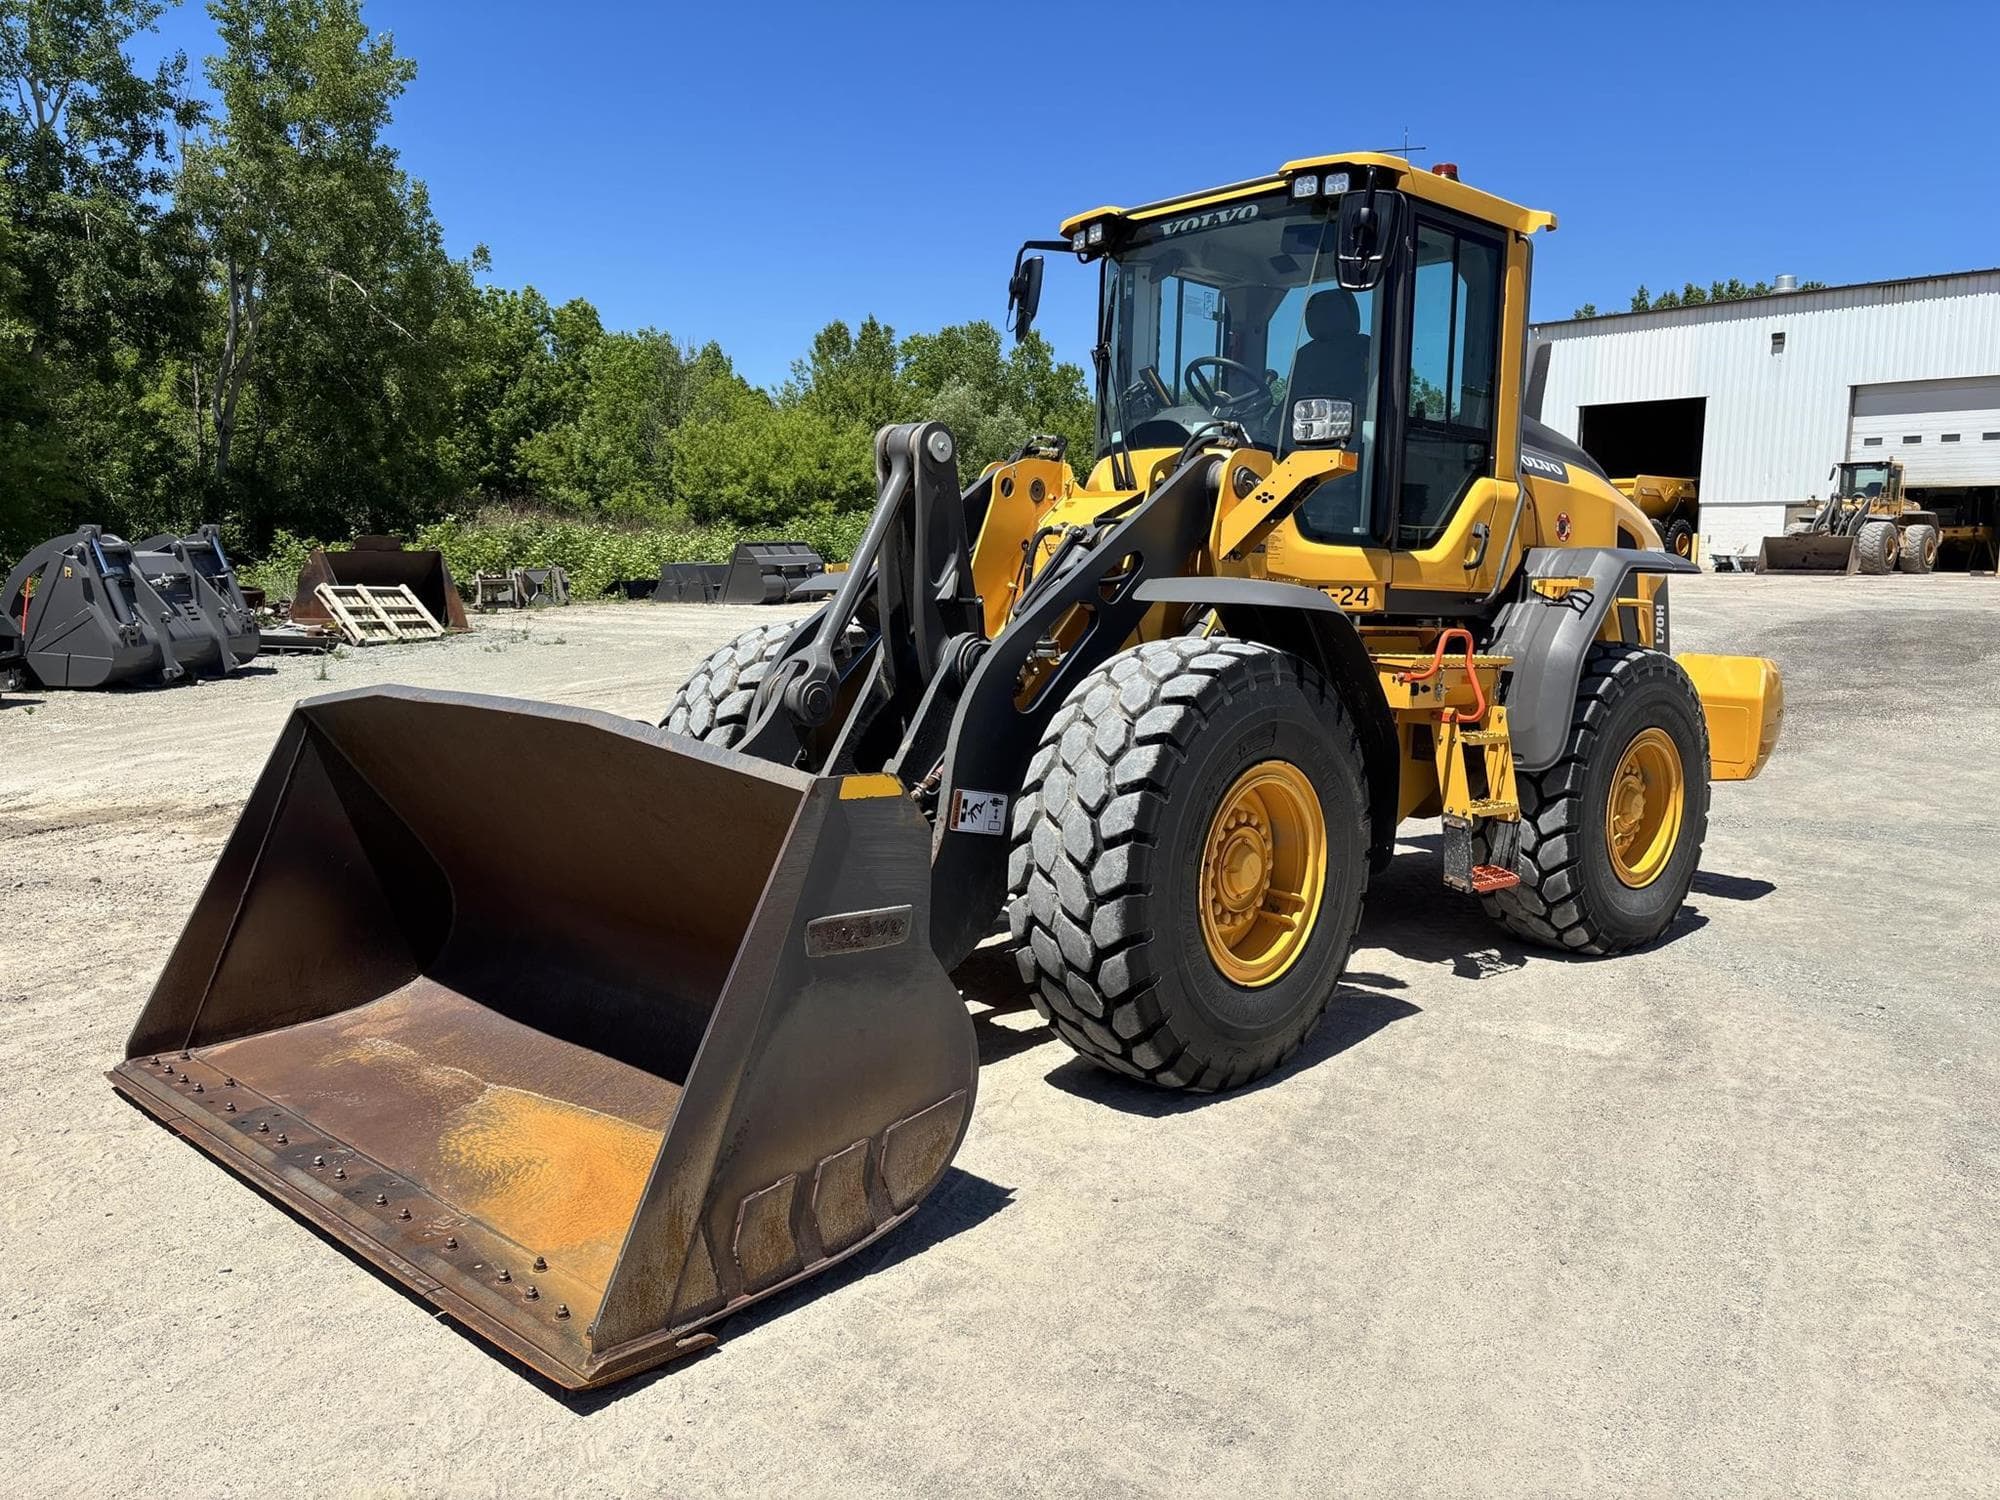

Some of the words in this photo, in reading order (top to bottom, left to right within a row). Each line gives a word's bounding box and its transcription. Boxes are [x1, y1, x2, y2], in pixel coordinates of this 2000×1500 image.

[1160, 204, 1259, 236] VOLVO
[1520, 454, 1564, 475] OLVO
[1655, 604, 1665, 644] L70H
